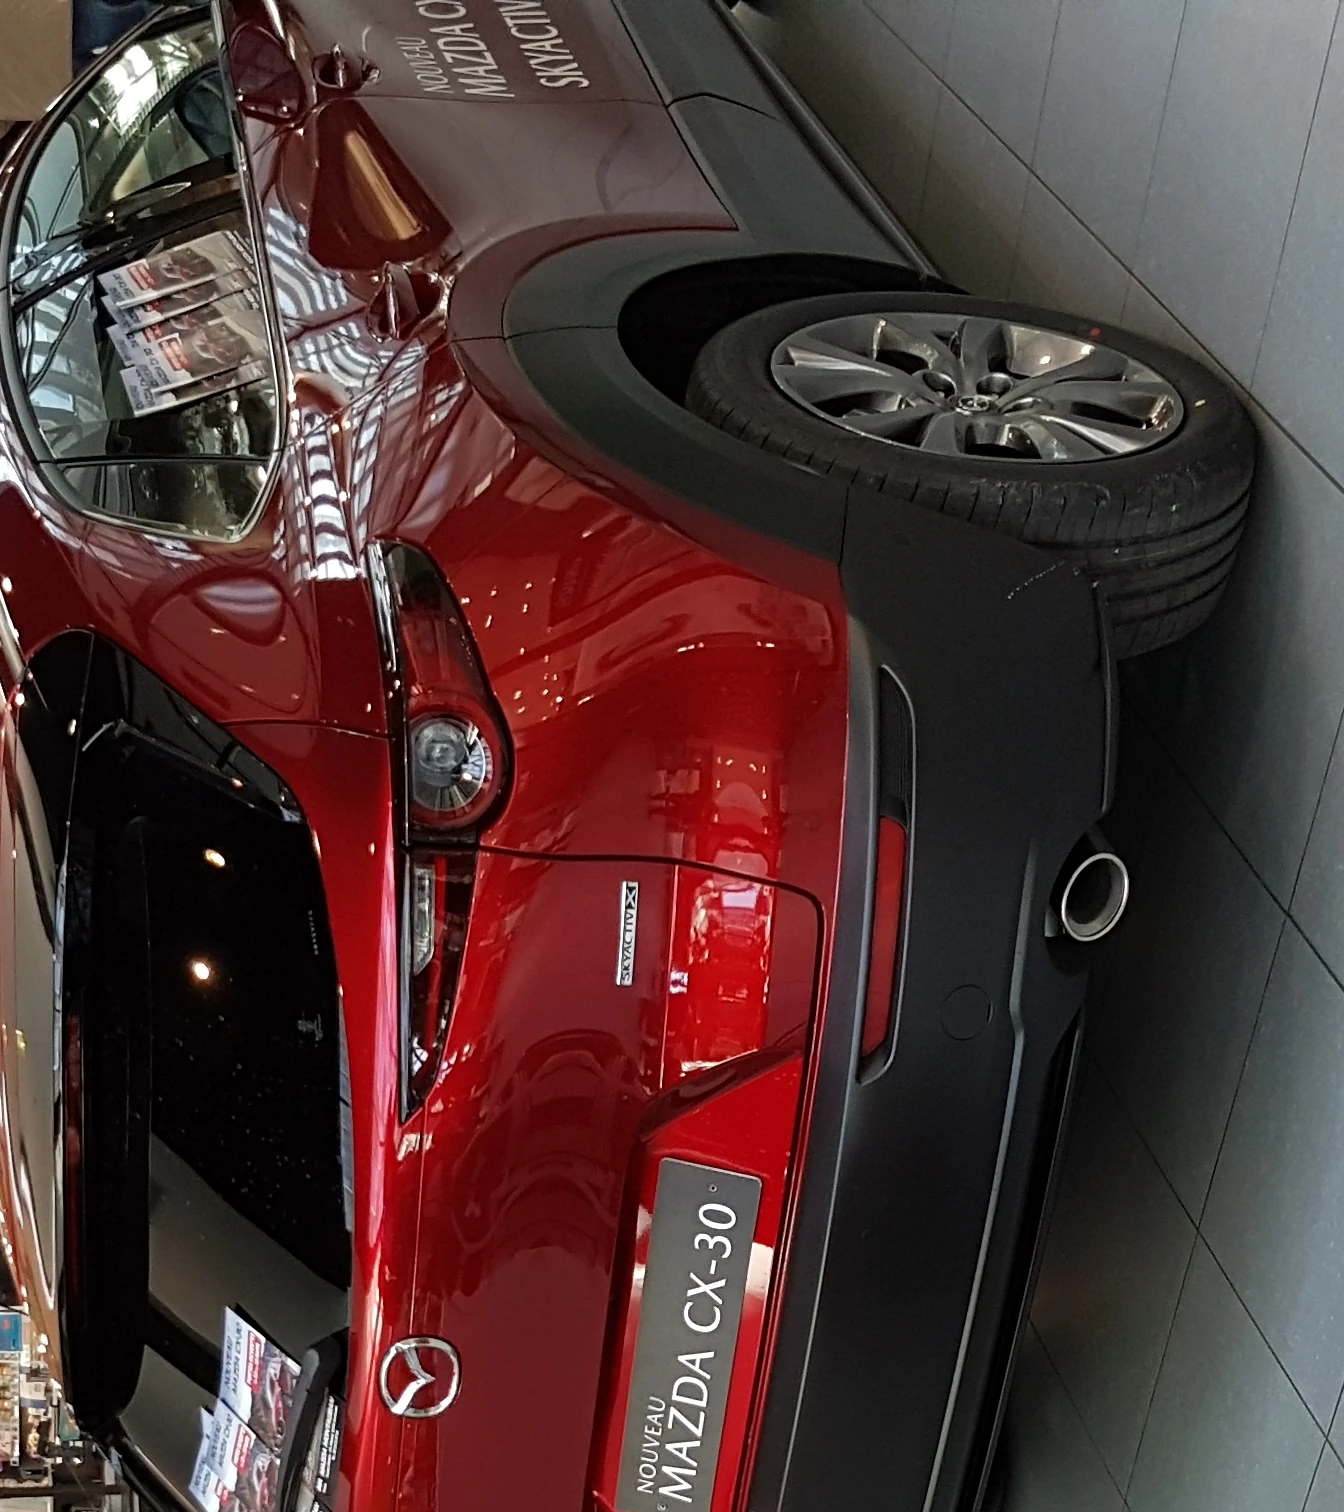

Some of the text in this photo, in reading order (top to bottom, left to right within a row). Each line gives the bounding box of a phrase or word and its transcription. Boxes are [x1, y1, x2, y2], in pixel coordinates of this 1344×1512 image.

[395, 36, 454, 94] NOUVEAU
[429, 23, 515, 98] MAZDA
[492, 0, 590, 88] SKYACTIV
[621, 912, 634, 982] SKYACTIV
[658, 1202, 738, 1504] MAZDA CX-30
[636, 1395, 667, 1494] NOUVEAU
